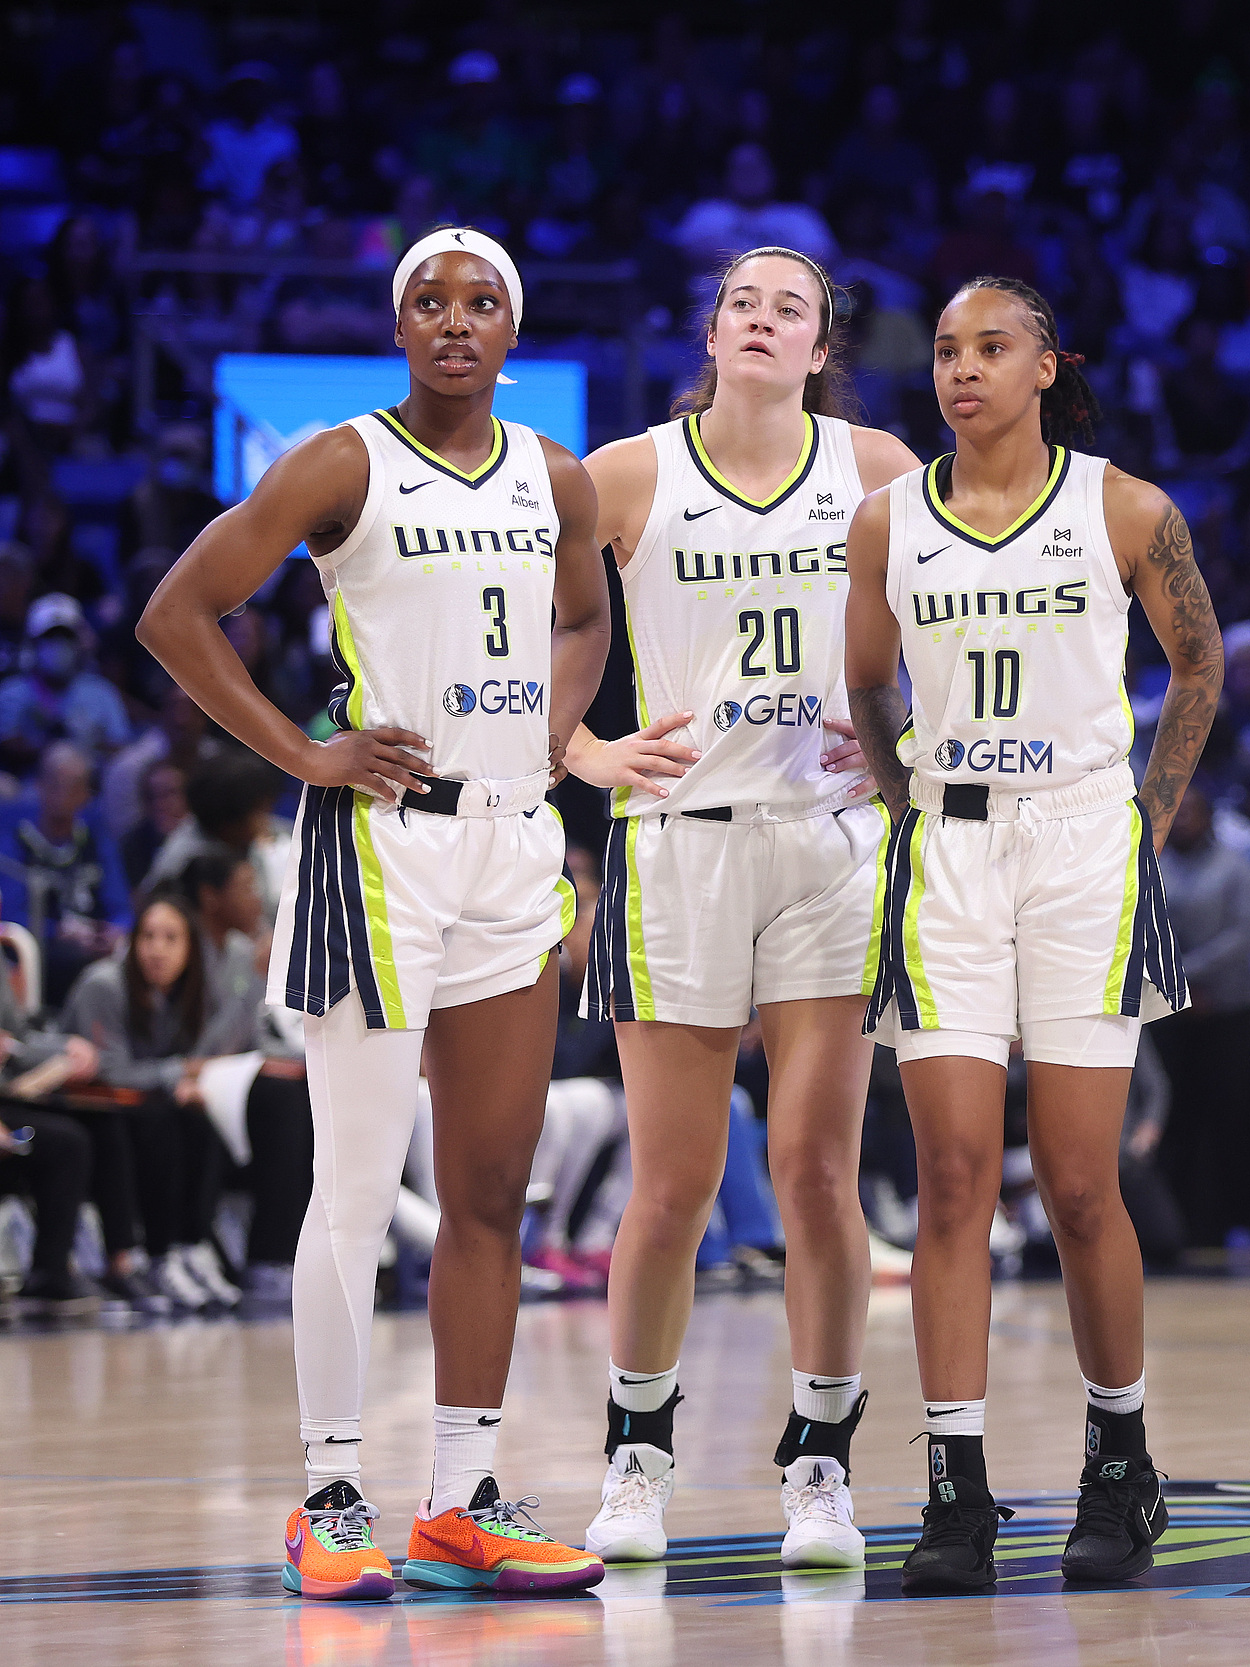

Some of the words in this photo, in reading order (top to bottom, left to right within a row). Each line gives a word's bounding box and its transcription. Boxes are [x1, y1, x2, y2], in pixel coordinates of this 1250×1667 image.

[511, 494, 540, 511] Albert
[808, 508, 846, 521] Albert
[390, 523, 554, 561] WINGS
[1041, 544, 1083, 558] Albert
[422, 560, 549, 574] DALLAS
[697, 581, 837, 600] DALLAS
[911, 578, 1089, 630] WINGS
[480, 584, 511, 660] 3
[932, 623, 1066, 643] DALLAS
[736, 605, 804, 680] 20
[479, 679, 545, 716] GEM
[965, 647, 1023, 722] 10
[744, 694, 822, 729] GEM
[967, 738, 1053, 774] GEM
